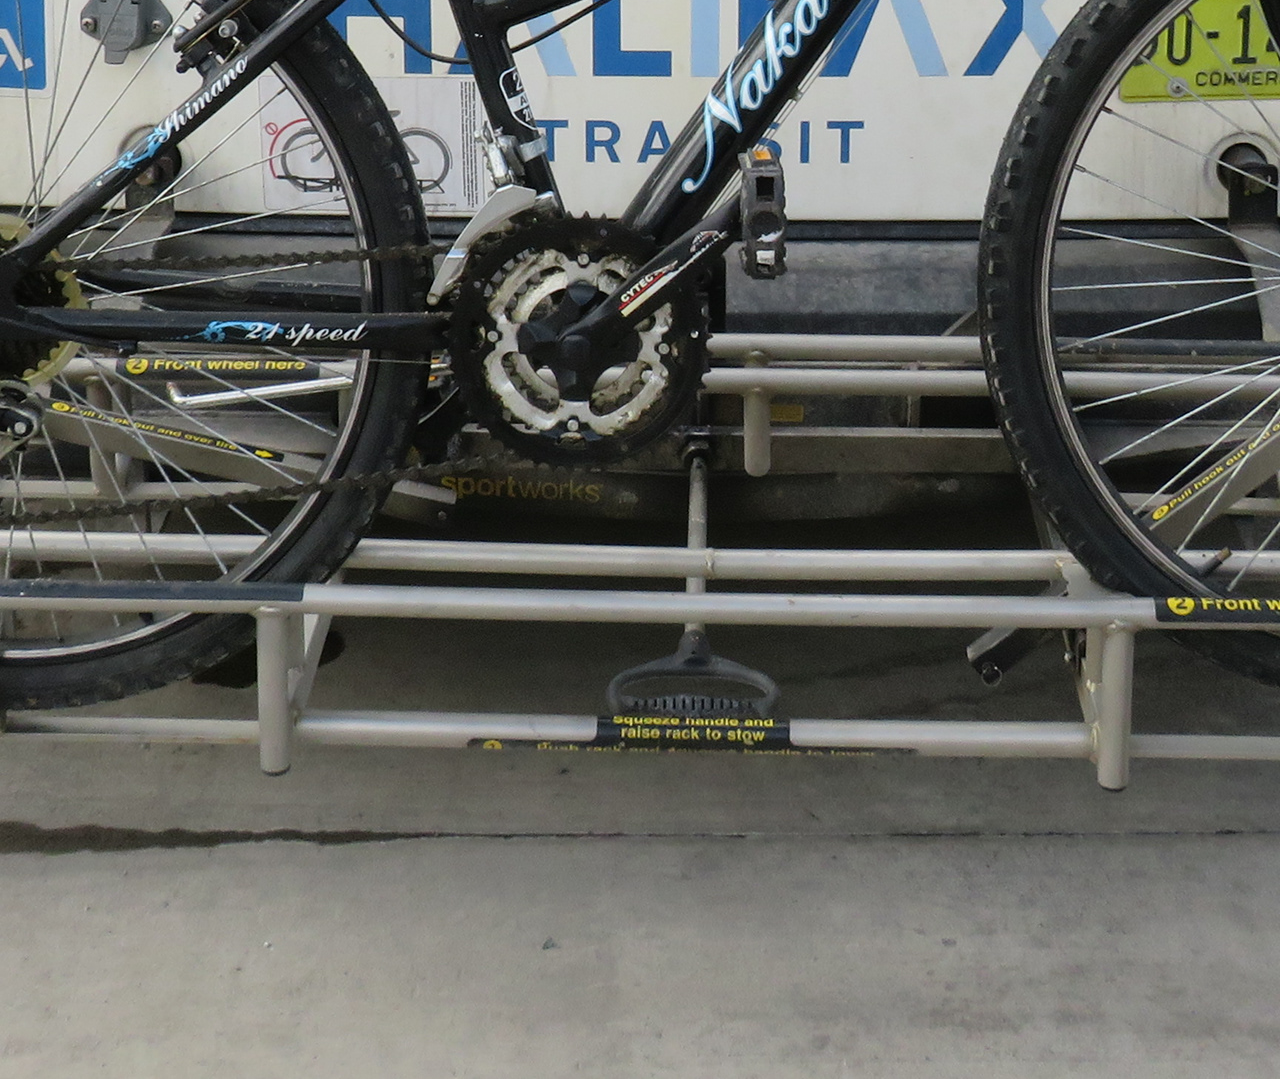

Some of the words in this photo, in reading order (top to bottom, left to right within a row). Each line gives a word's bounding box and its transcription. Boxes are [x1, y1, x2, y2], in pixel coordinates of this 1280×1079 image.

[158, 55, 248, 142] Shimano
[621, 273, 654, 302] CYTEC
[245, 323, 280, 340] 21
[285, 320, 368, 347] speed
[153, 359, 202, 370] Front
[213, 359, 260, 370] wheel
[134, 422, 154, 431] out
[157, 428, 181, 438] and
[184, 434, 213, 444] over
[216, 440, 238, 451] tire
[441, 475, 603, 504] sportworks
[1169, 488, 1192, 508] Pull
[1194, 465, 1224, 490] hook
[1226, 449, 1247, 467] out
[1201, 598, 1261, 611] Front
[613, 715, 680, 726] Squeeze
[744, 718, 774, 727] and
[621, 726, 660, 739] raise
[666, 727, 699, 740] rack
[706, 728, 721, 740] to
[728, 728, 766, 742] stow
